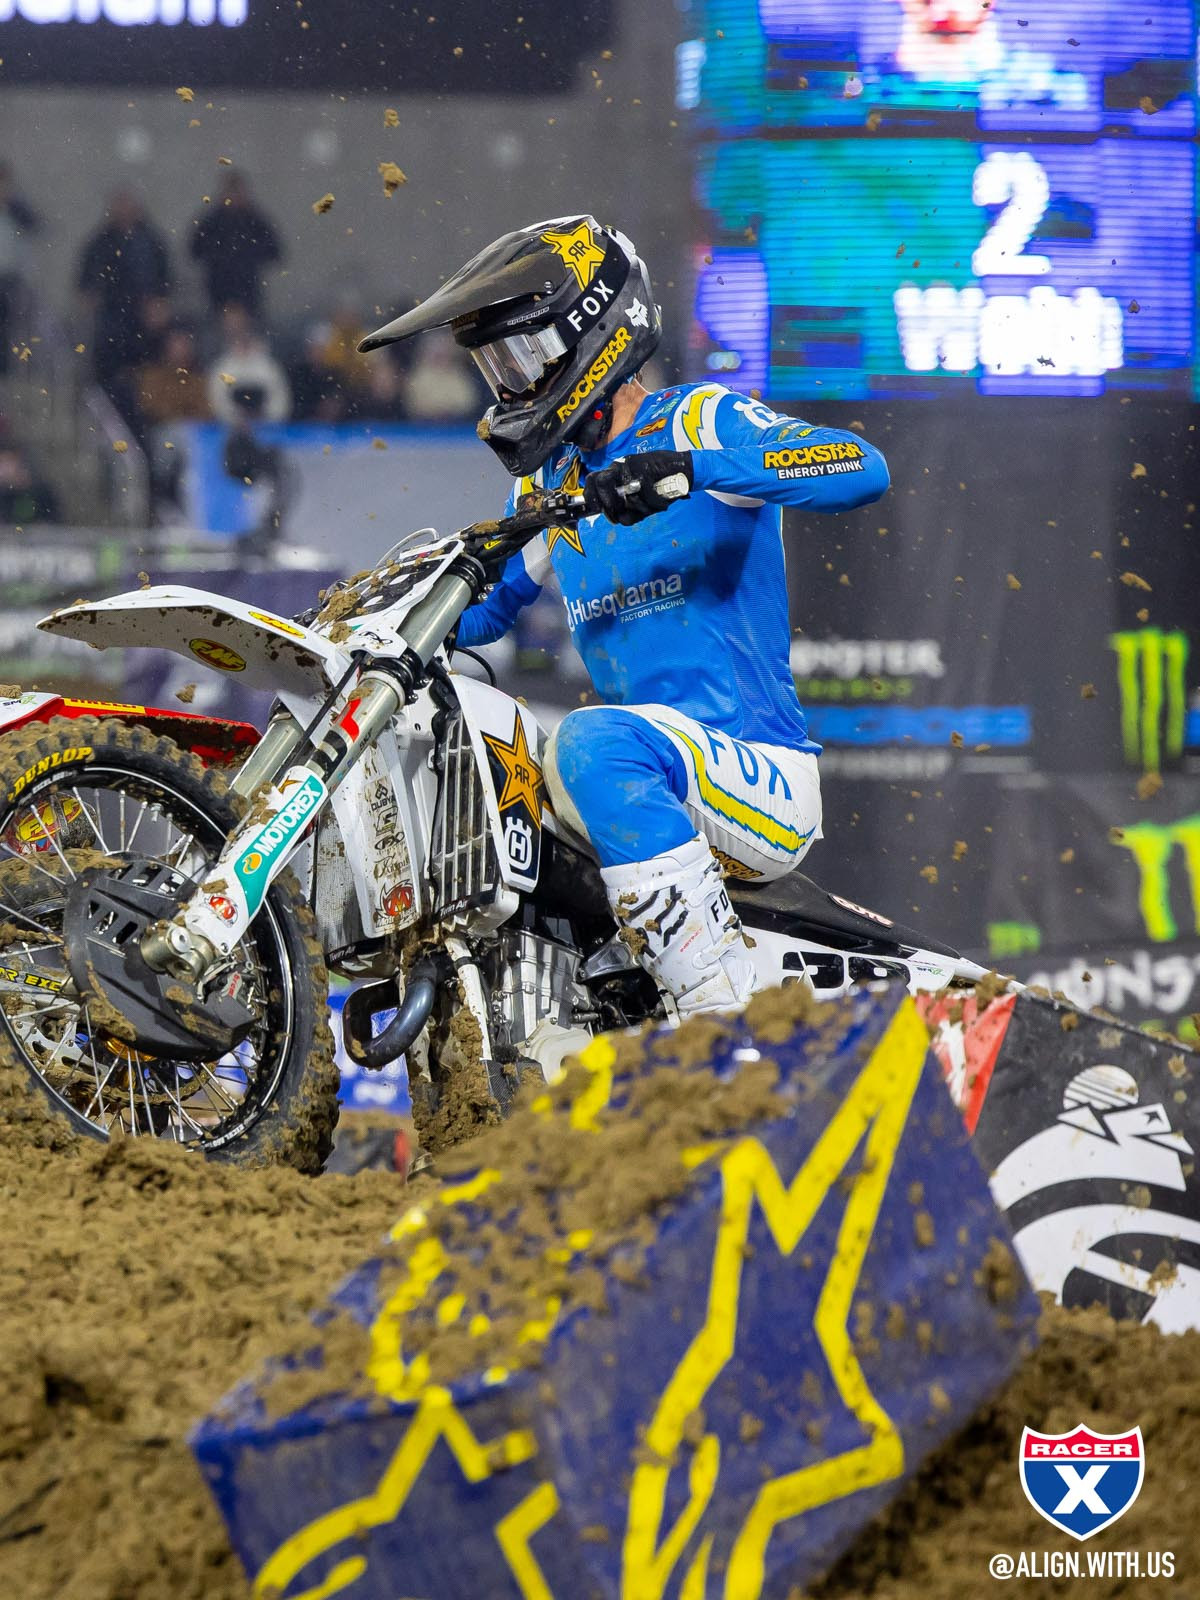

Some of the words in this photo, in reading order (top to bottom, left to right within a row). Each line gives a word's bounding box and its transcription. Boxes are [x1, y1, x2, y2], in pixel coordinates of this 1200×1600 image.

[971, 151, 1051, 277] 2
[567, 279, 614, 332] FOX
[557, 327, 632, 424] ROCKSTAR
[764, 443, 865, 468] ROCKSTAR
[778, 466, 825, 480] ENERGY
[826, 460, 864, 474] DRINK
[570, 573, 682, 625] Husqvarna
[620, 606, 653, 624] FACTORY
[654, 597, 686, 613] RACING
[13, 746, 94, 797] DUNLOP
[253, 780, 320, 857] MOTOREX
